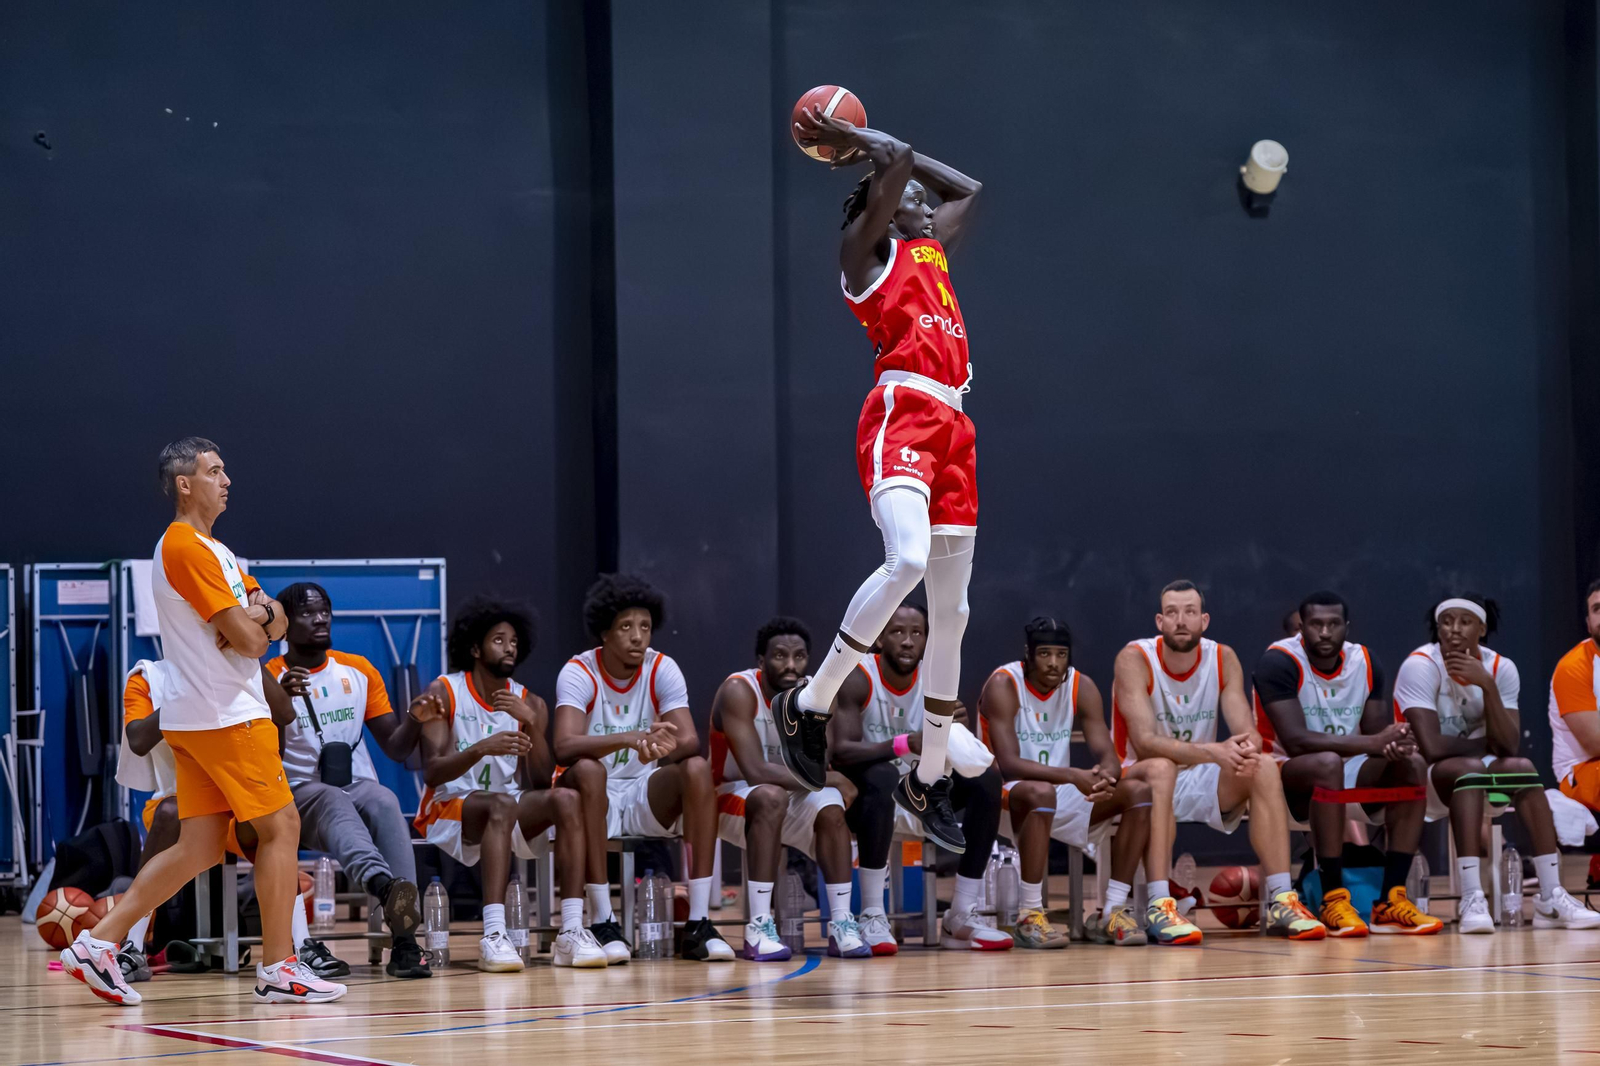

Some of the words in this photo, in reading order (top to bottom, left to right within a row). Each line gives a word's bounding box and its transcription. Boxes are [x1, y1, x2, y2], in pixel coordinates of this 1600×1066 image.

[919, 314, 966, 339] ende
[320, 707, 354, 725] D'IVOIRE
[478, 763, 491, 791] 4
